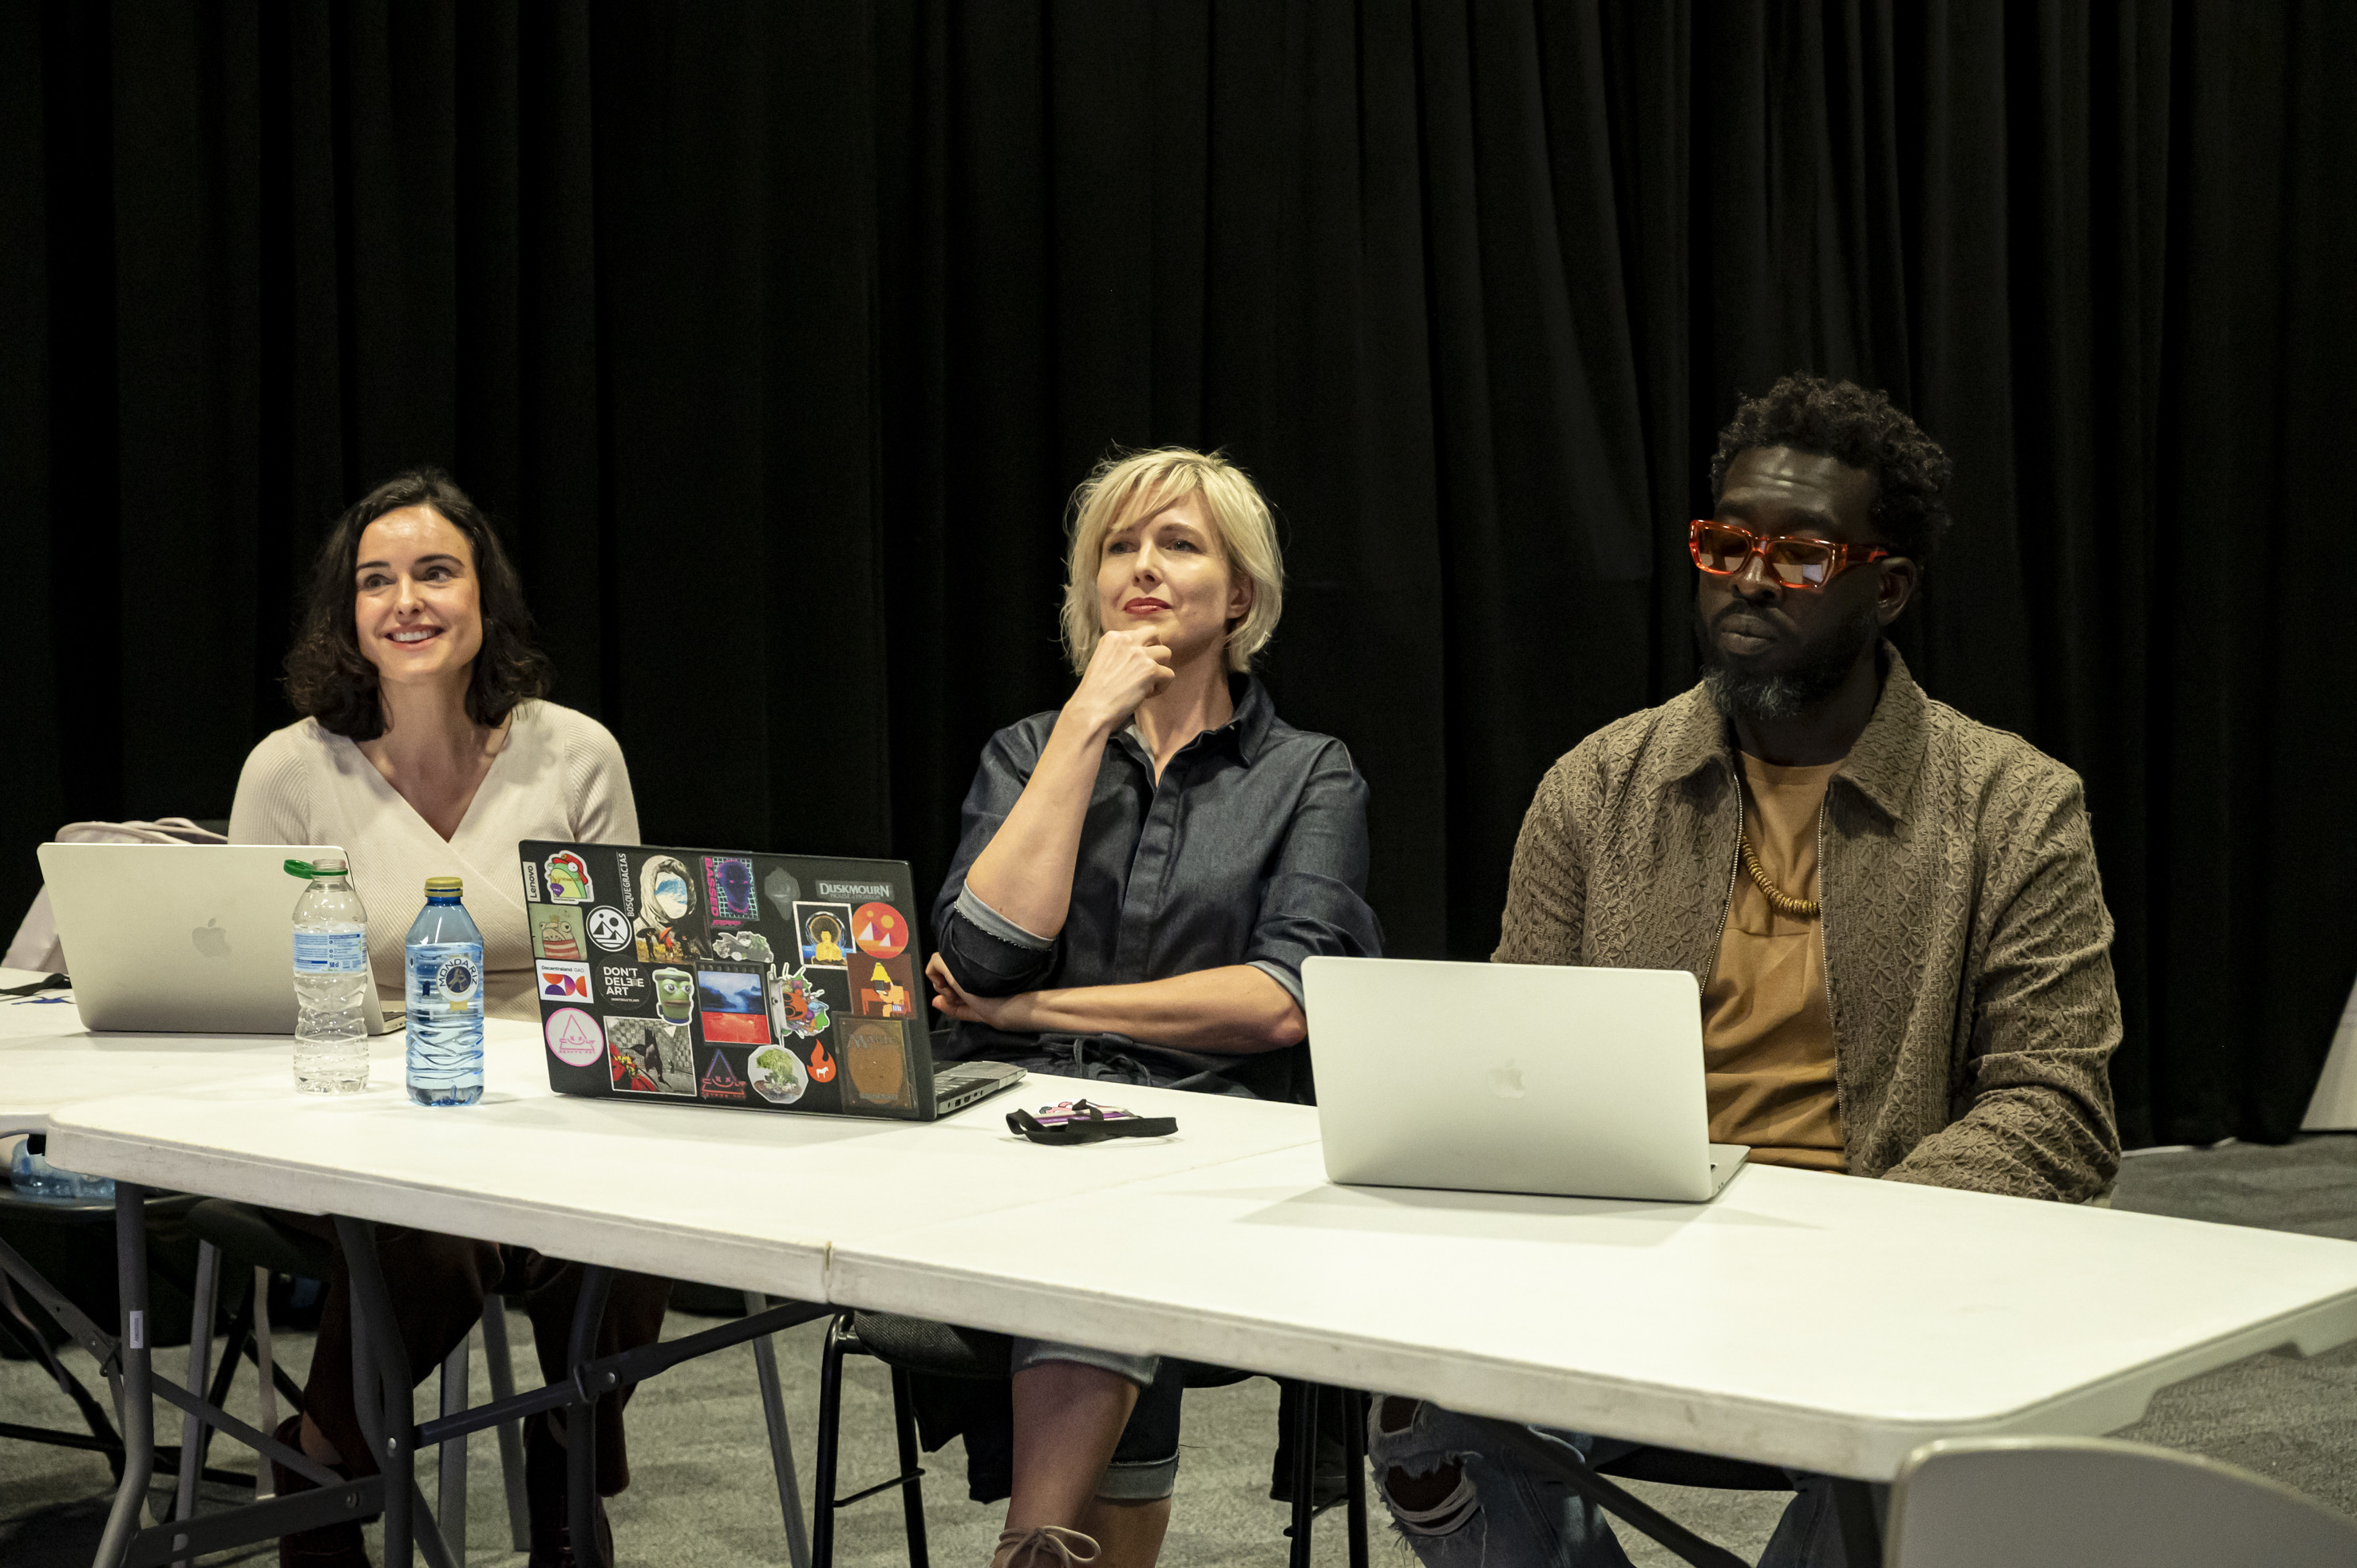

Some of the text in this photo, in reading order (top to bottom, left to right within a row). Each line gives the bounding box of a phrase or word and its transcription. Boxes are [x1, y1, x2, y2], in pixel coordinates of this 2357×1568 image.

[528, 865, 537, 899] Lenovo
[619, 853, 635, 917] BOSQUEGRACIAS
[819, 883, 889, 897] DUSKMOURN
[439, 958, 477, 987] MONDARIZ
[603, 966, 638, 978] DON'T
[607, 987, 629, 996] ART
